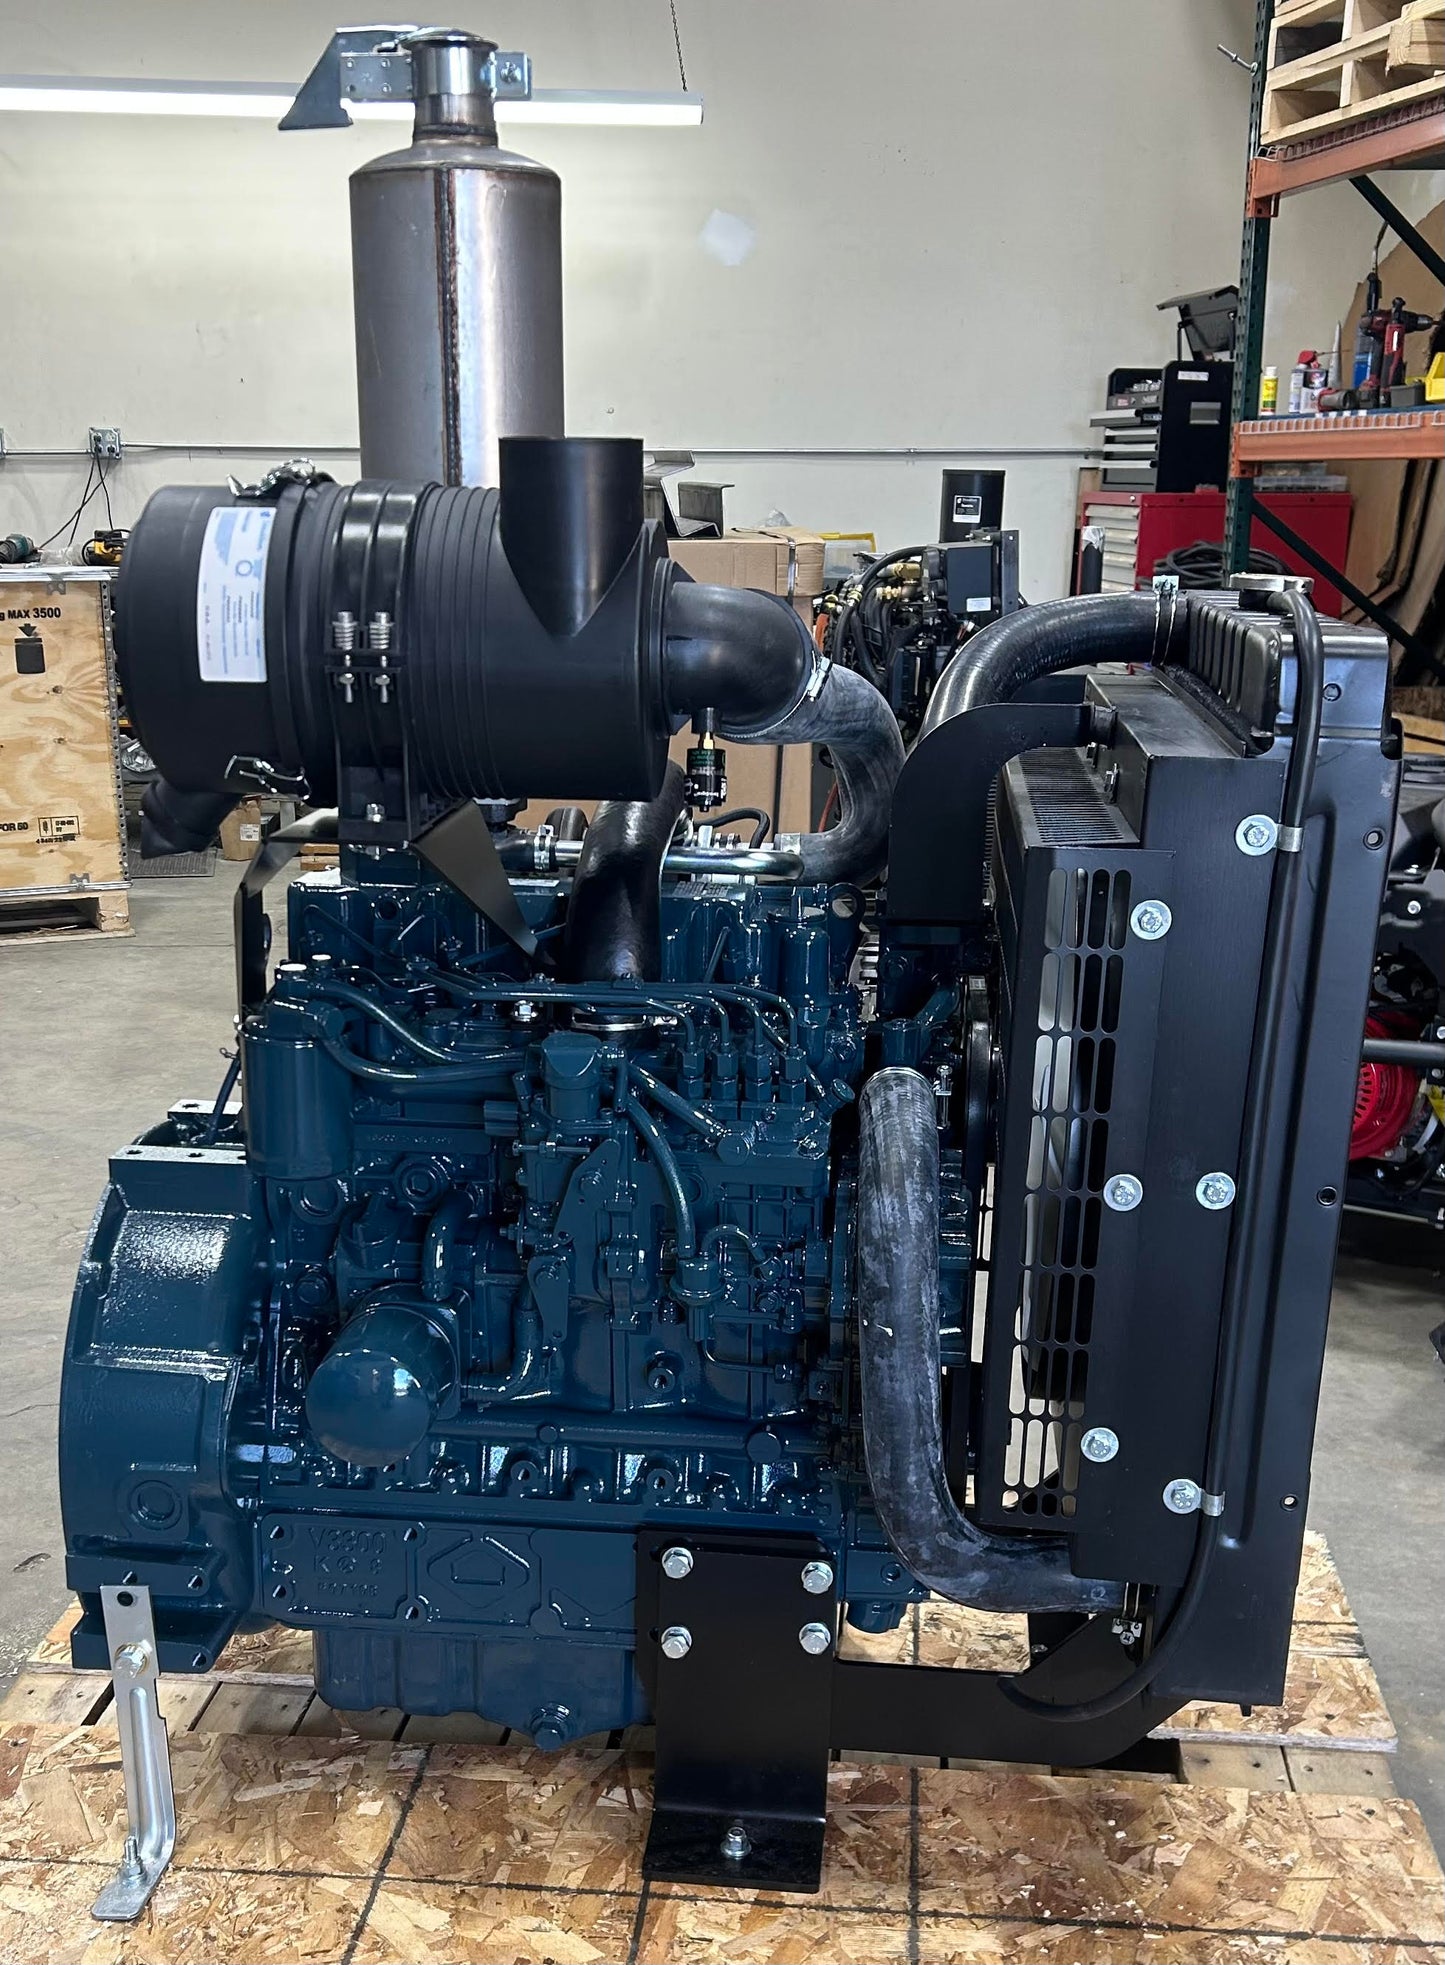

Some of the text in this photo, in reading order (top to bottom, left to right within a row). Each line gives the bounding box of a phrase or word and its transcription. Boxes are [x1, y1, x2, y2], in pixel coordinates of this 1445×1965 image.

[8, 609, 30, 619] MAX
[32, 607, 61, 618] 3500
[308, 1528, 385, 1554] V3300
